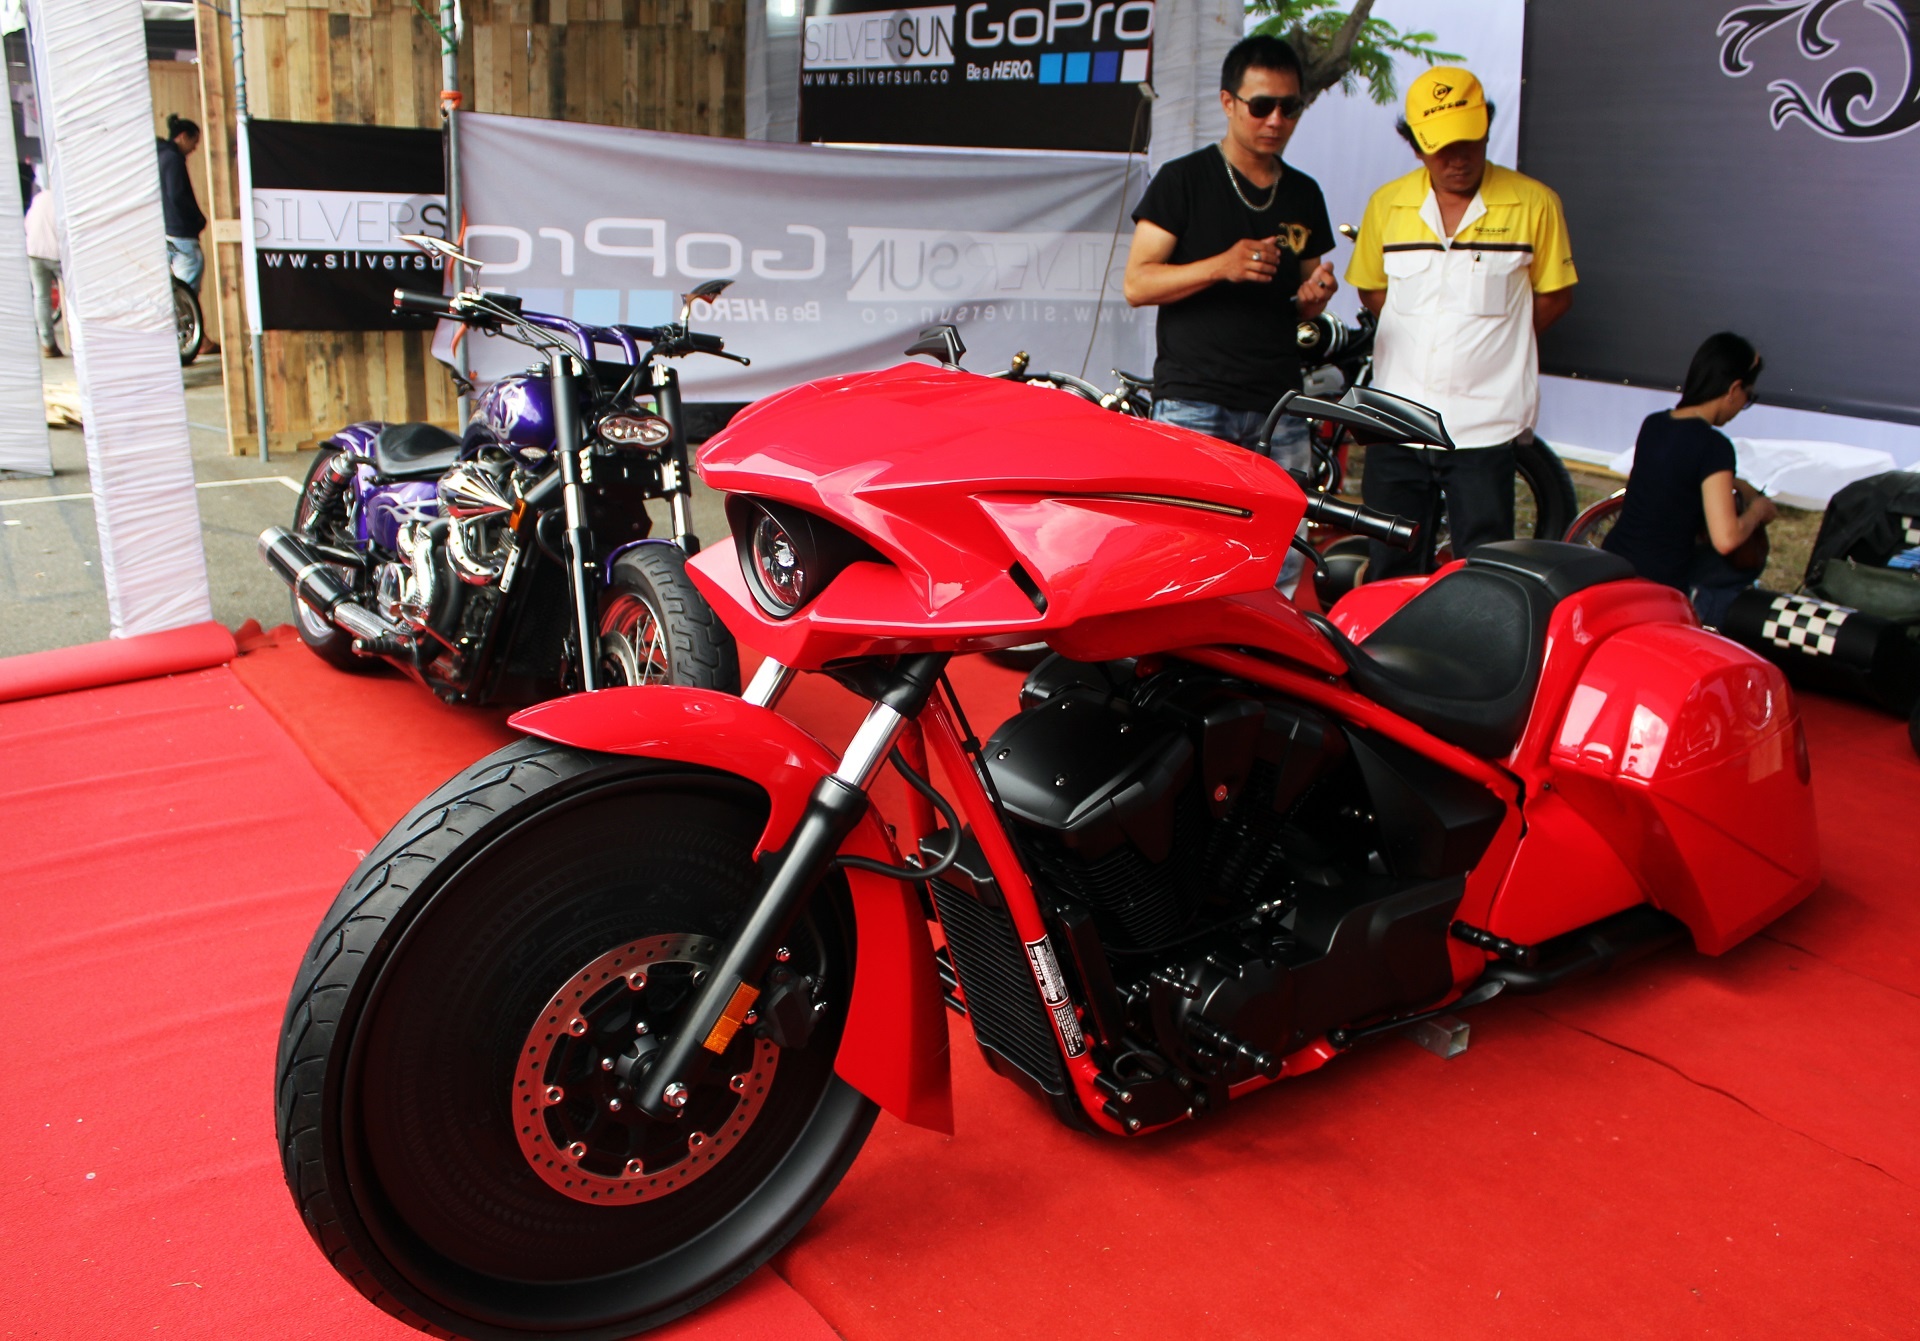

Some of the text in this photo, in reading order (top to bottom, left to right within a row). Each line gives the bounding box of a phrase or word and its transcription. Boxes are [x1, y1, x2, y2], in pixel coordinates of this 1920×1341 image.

[803, 11, 955, 62] SILVERSUN
[965, 0, 1154, 47] GoPro
[802, 68, 949, 86] www.silversun.co
[966, 63, 981, 80] Be
[982, 66, 990, 79] a
